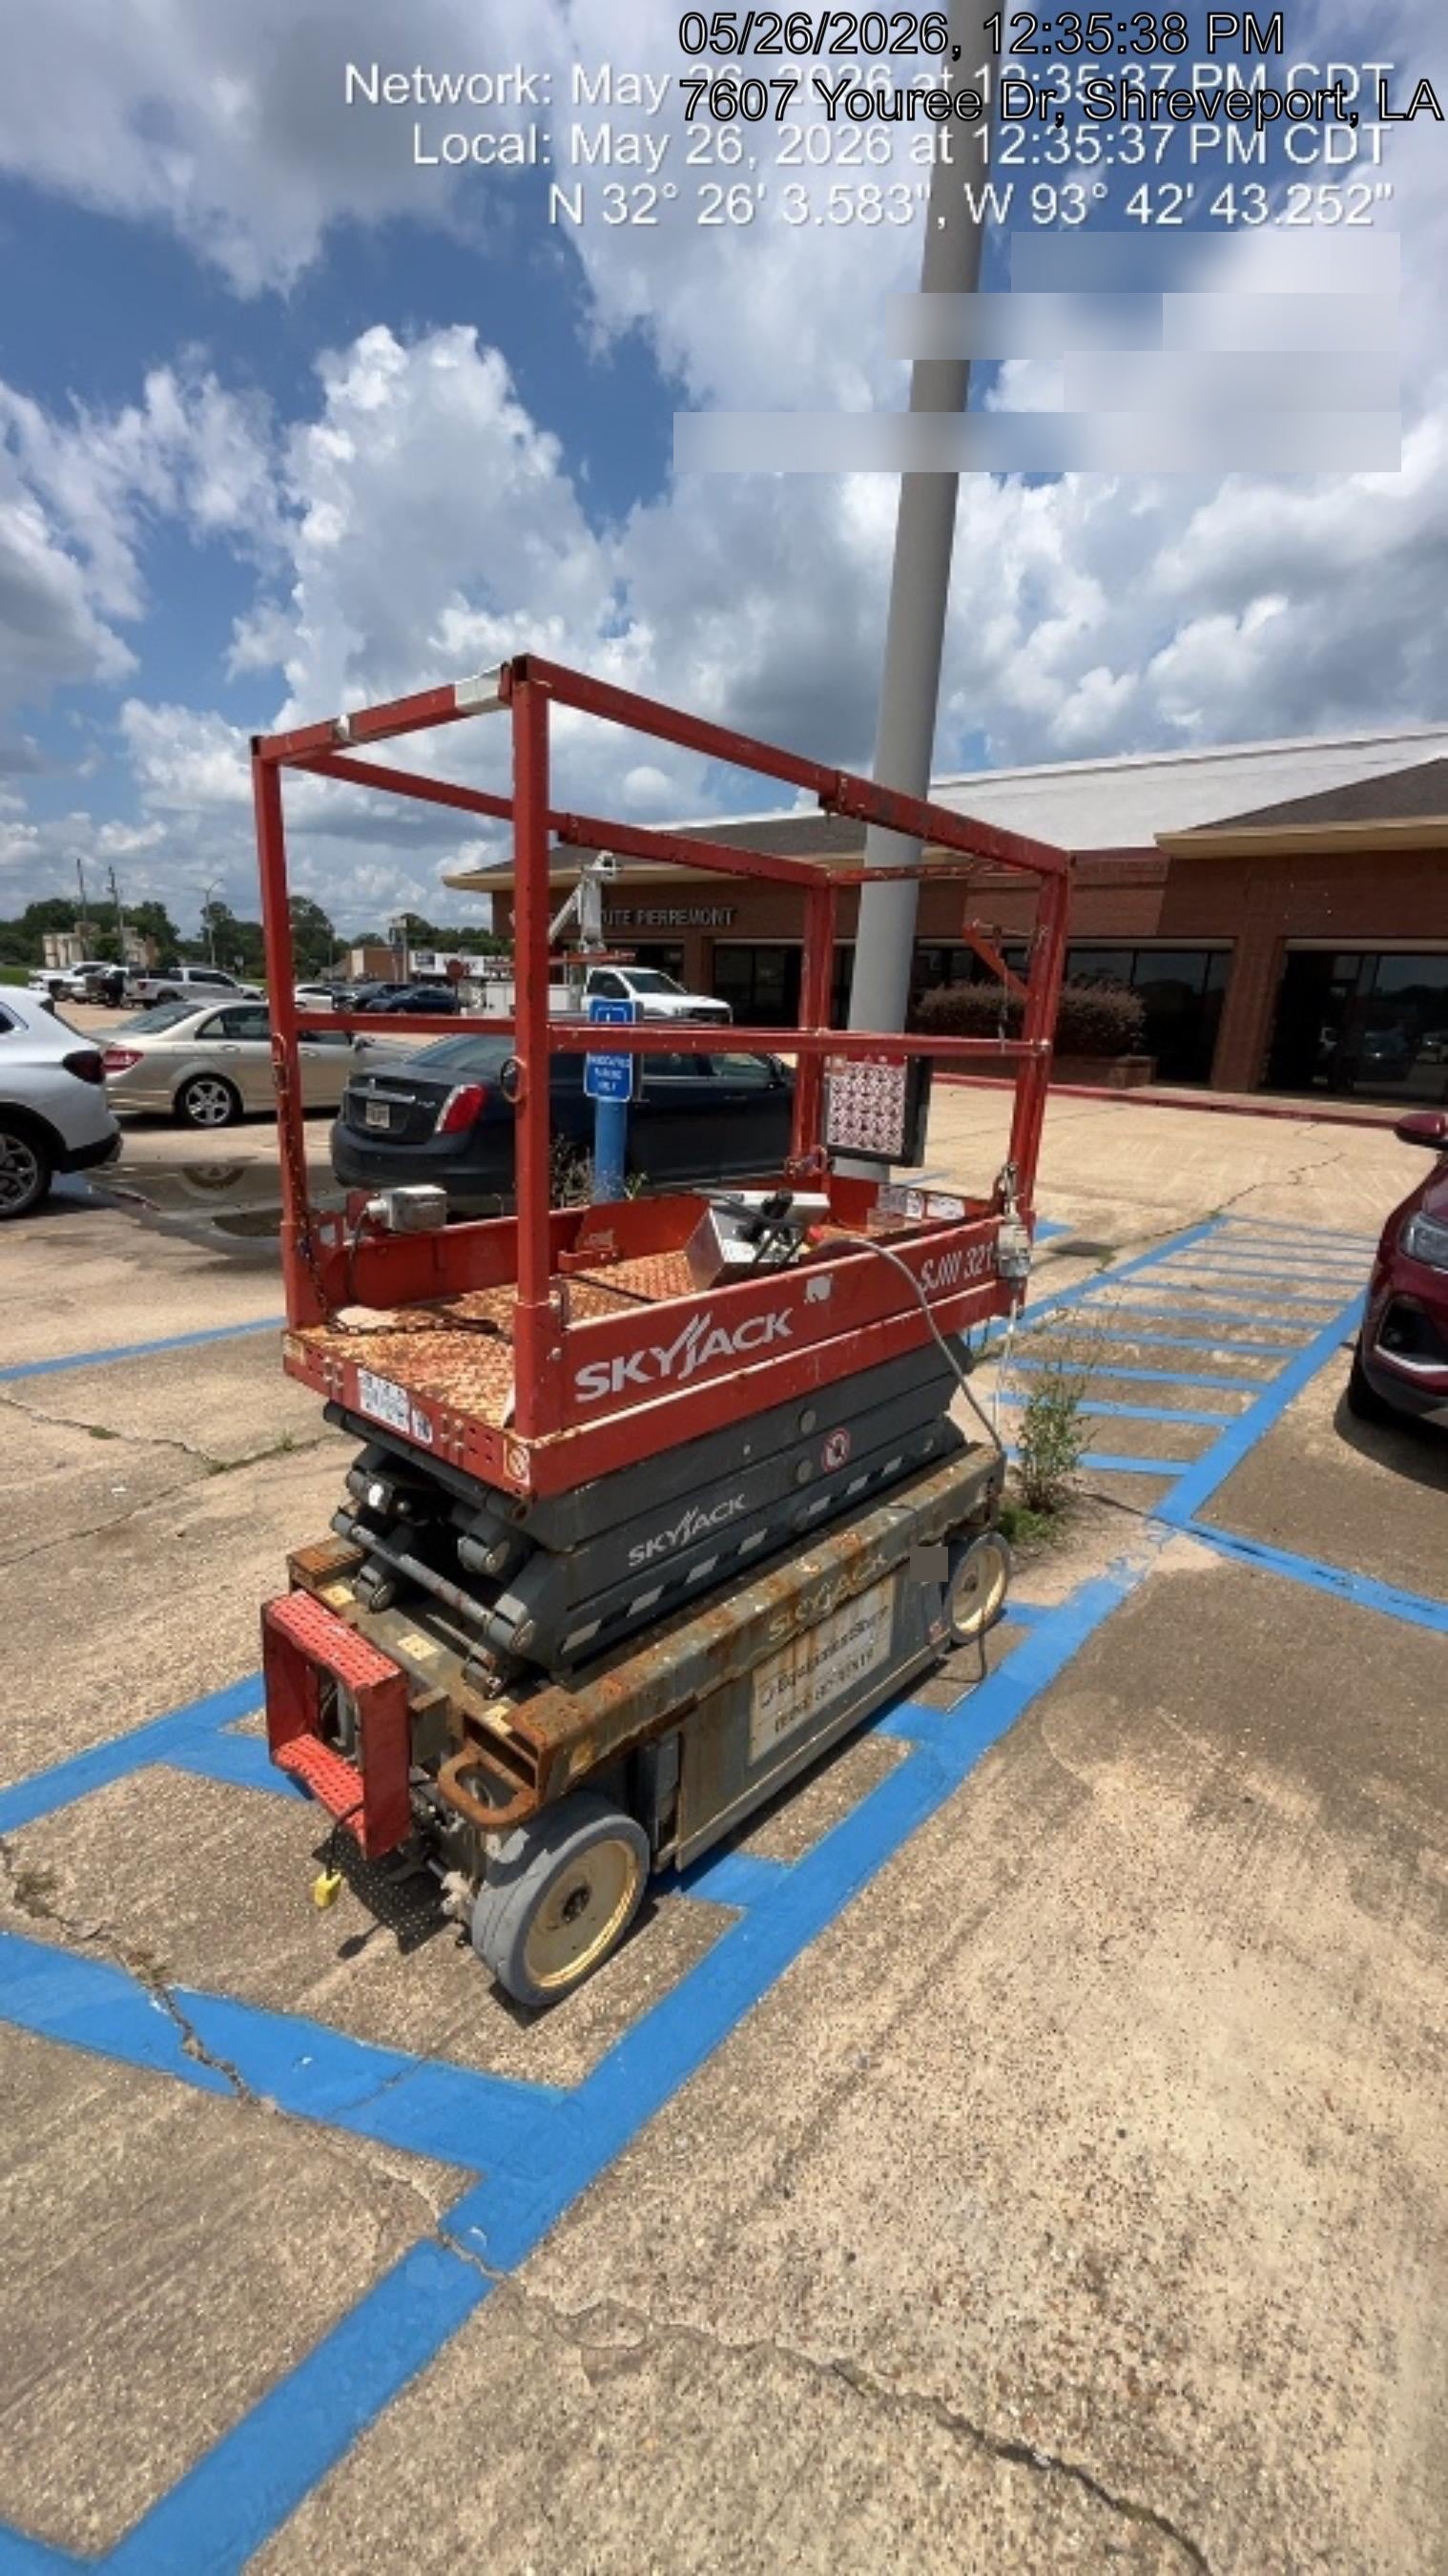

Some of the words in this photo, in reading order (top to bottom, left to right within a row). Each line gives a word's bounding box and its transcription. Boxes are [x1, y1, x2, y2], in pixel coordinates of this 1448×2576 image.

[637, 906, 733, 925] PIERREMONT
[963, 1241, 996, 1279] 321
[574, 1307, 794, 1403] SKYJACK
[629, 1493, 745, 1567] SKYJACK
